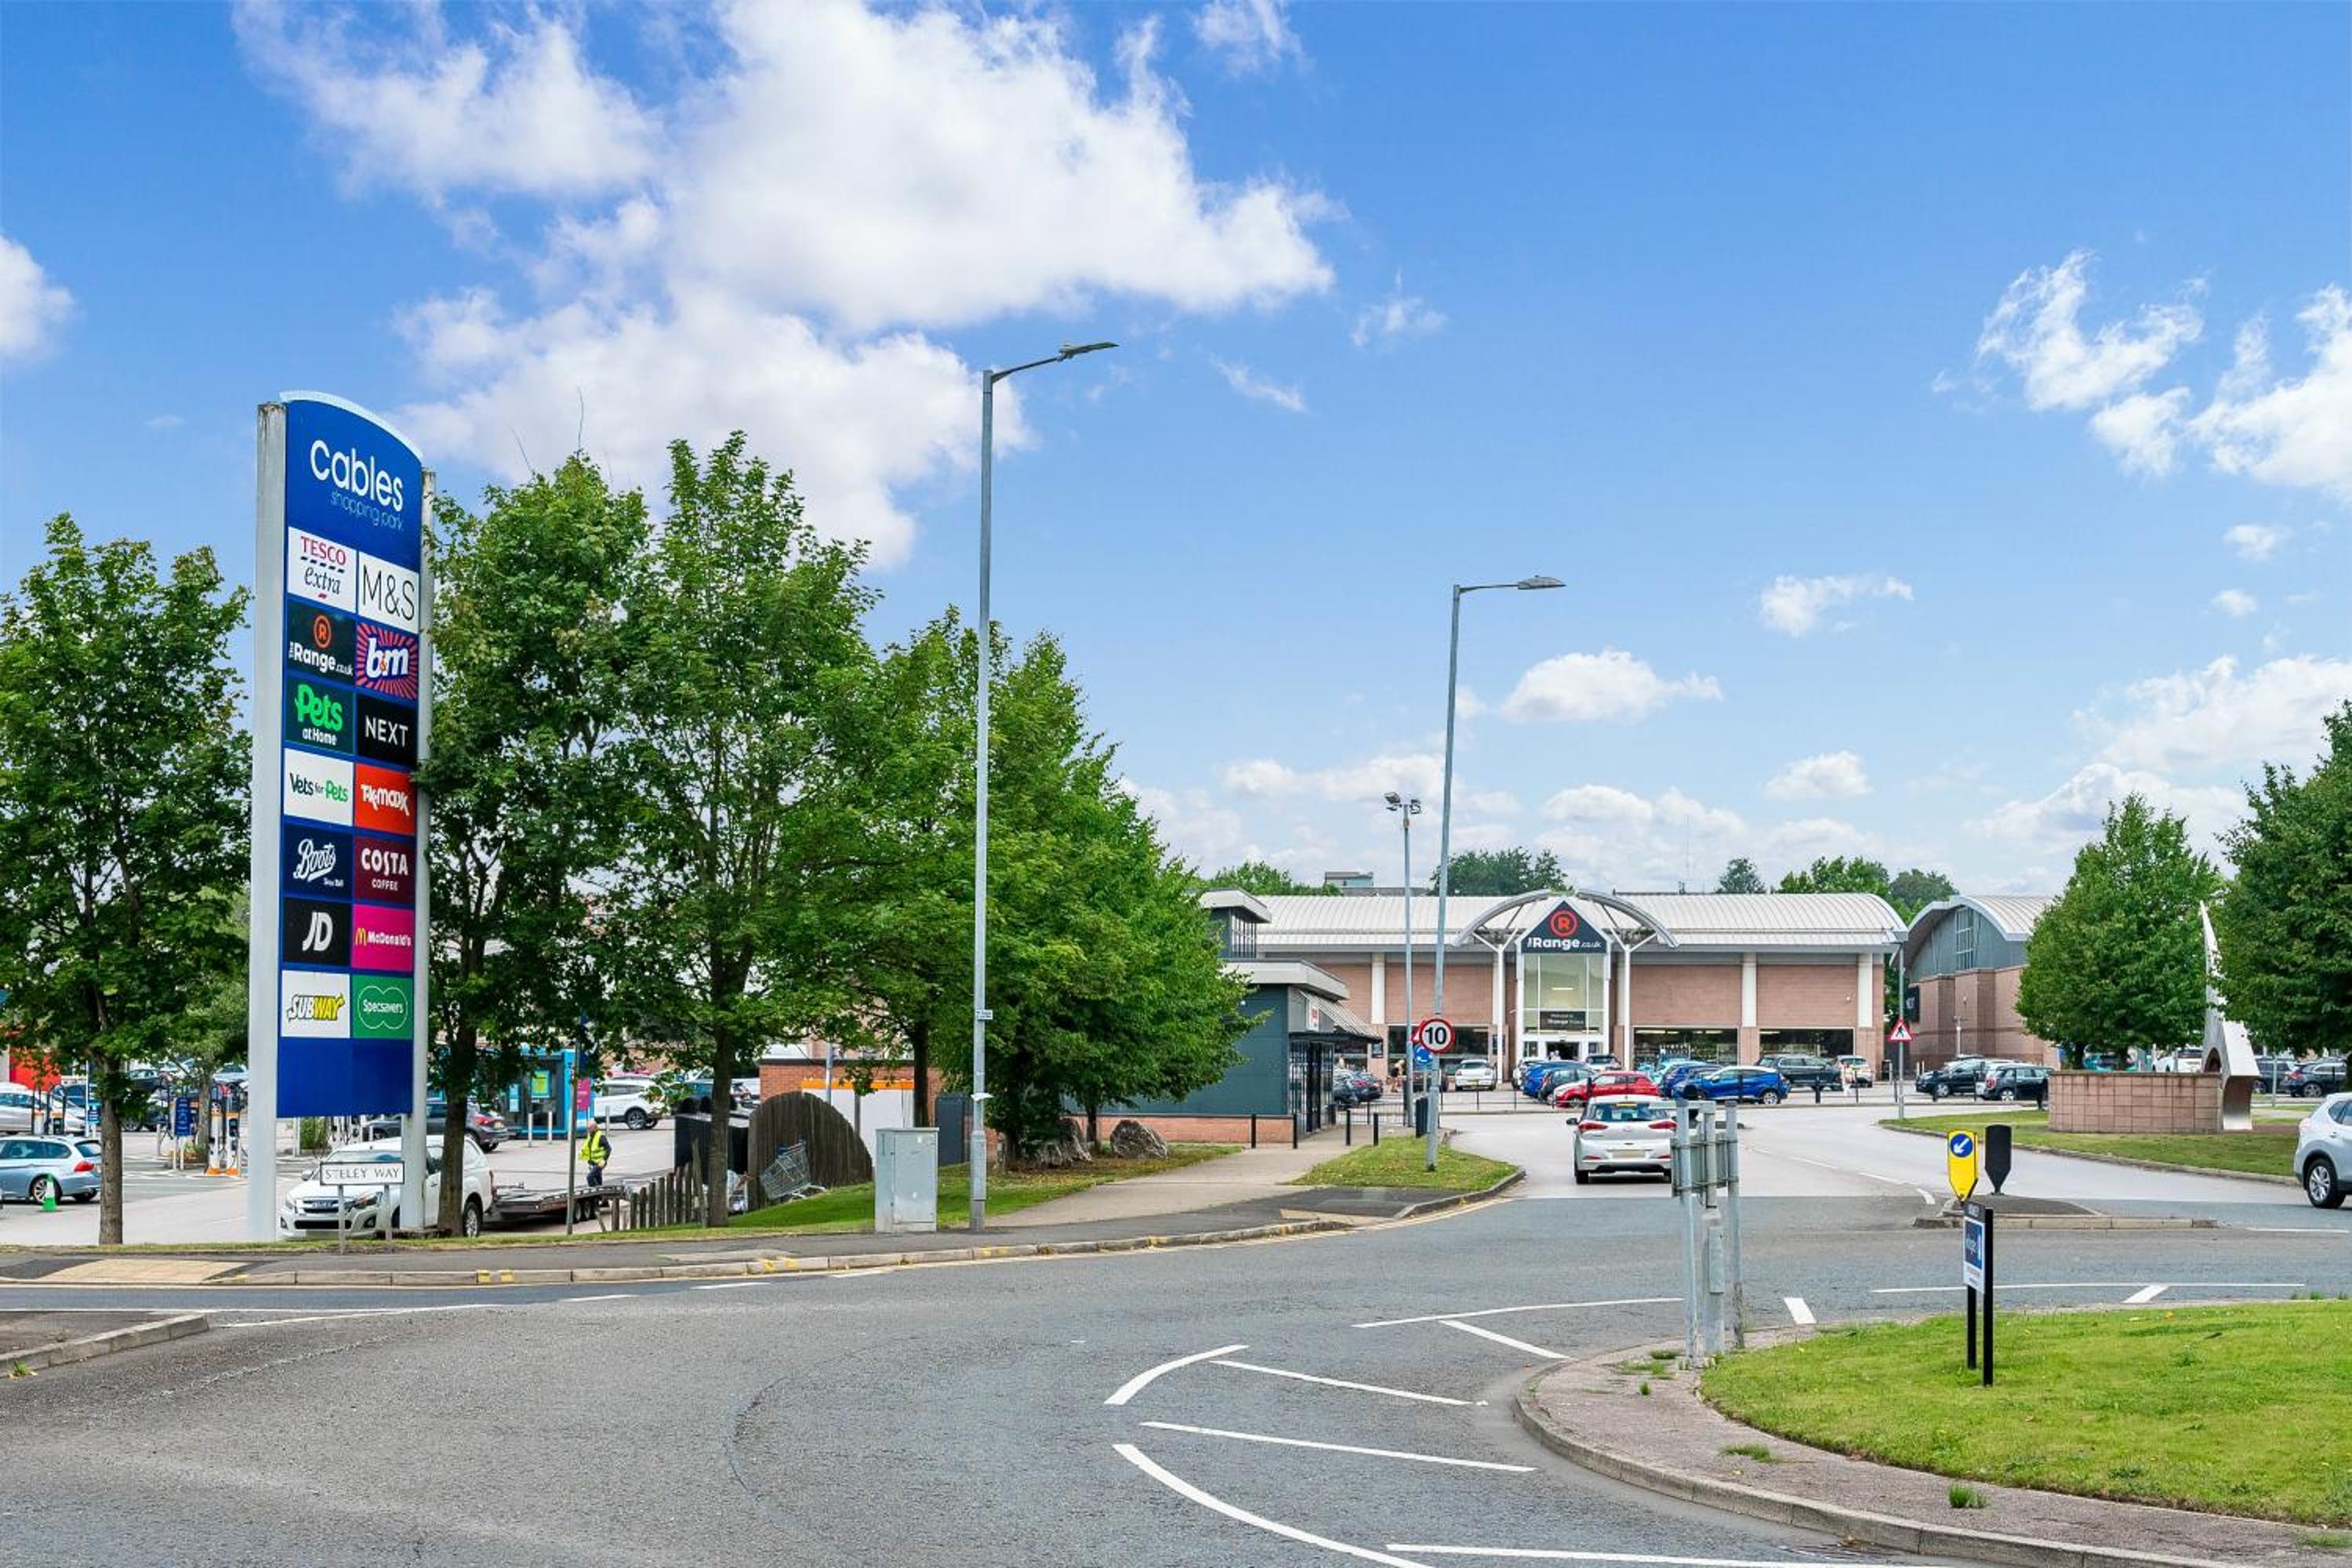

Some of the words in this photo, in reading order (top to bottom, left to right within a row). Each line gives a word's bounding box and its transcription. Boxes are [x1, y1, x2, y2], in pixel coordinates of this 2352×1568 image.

[310, 440, 404, 512] Cables
[332, 489, 380, 527] shopping
[300, 535, 347, 566] TESCO
[304, 565, 341, 595] extra
[363, 564, 416, 622] M&S
[295, 683, 343, 731] Pets
[313, 728, 337, 746] Home
[365, 714, 408, 747] NEXT
[289, 772, 314, 796] Vets
[326, 779, 349, 802] Pets
[293, 838, 336, 882] Boots
[361, 848, 408, 876] COSTA
[372, 879, 398, 891] COFFEE
[302, 912, 333, 951] JD
[367, 931, 412, 947] McDonald's
[287, 993, 346, 1022] SUBWAY
[363, 999, 404, 1014] Specsavers
[1425, 1026, 1447, 1044] 10
[374, 1167, 400, 1178] WAY
